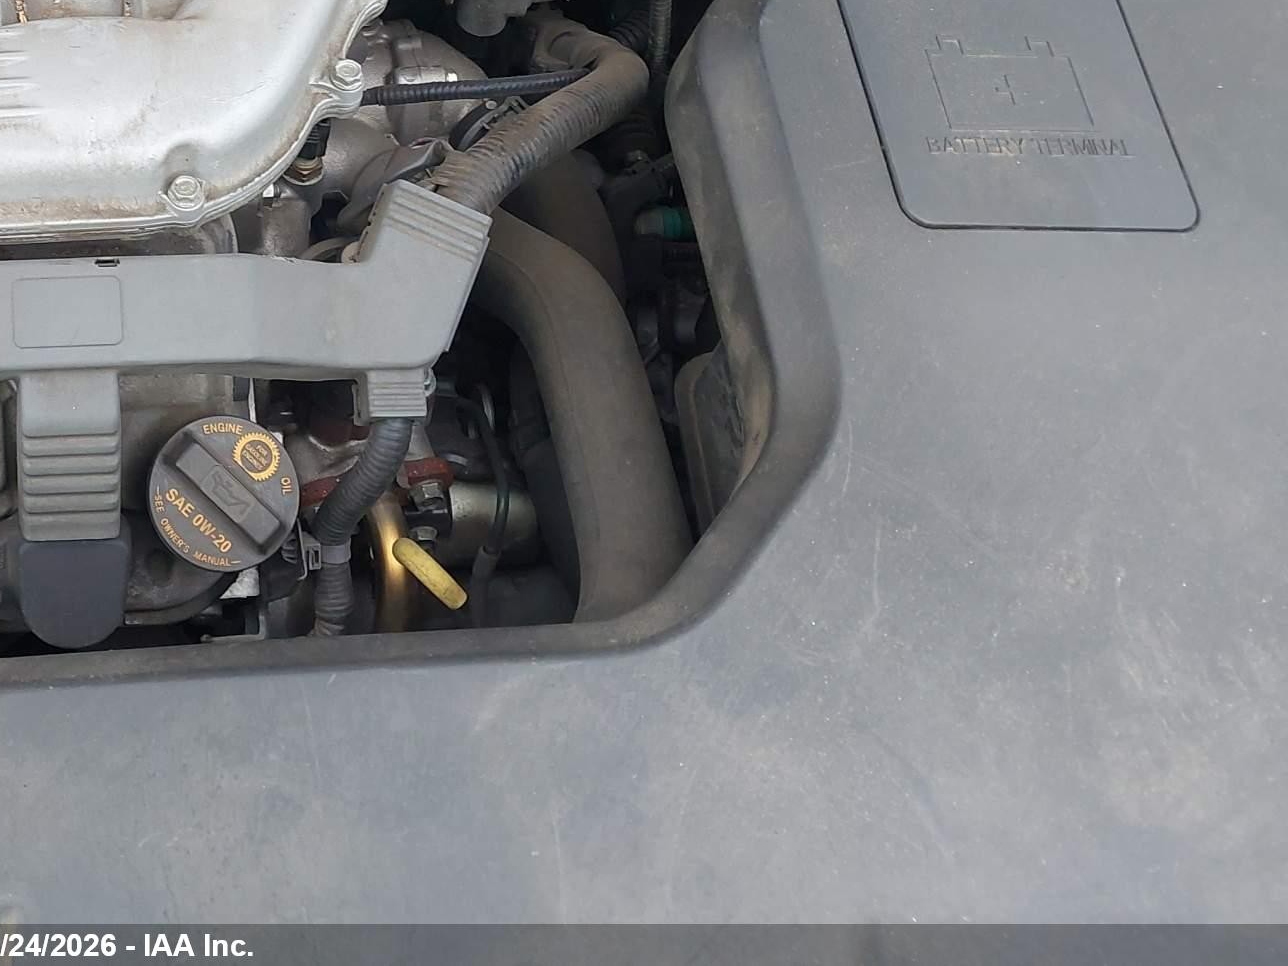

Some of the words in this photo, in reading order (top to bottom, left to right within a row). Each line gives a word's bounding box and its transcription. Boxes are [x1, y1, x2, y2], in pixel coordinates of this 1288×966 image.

[925, 137, 1024, 156] BATTERY
[1029, 137, 1133, 157] TERMINAL
[202, 422, 244, 435] ENGINE
[280, 477, 293, 496] OIL
[160, 517, 190, 554] OWNER'S
[165, 488, 195, 518] SAE
[192, 513, 232, 553] 0W-20
